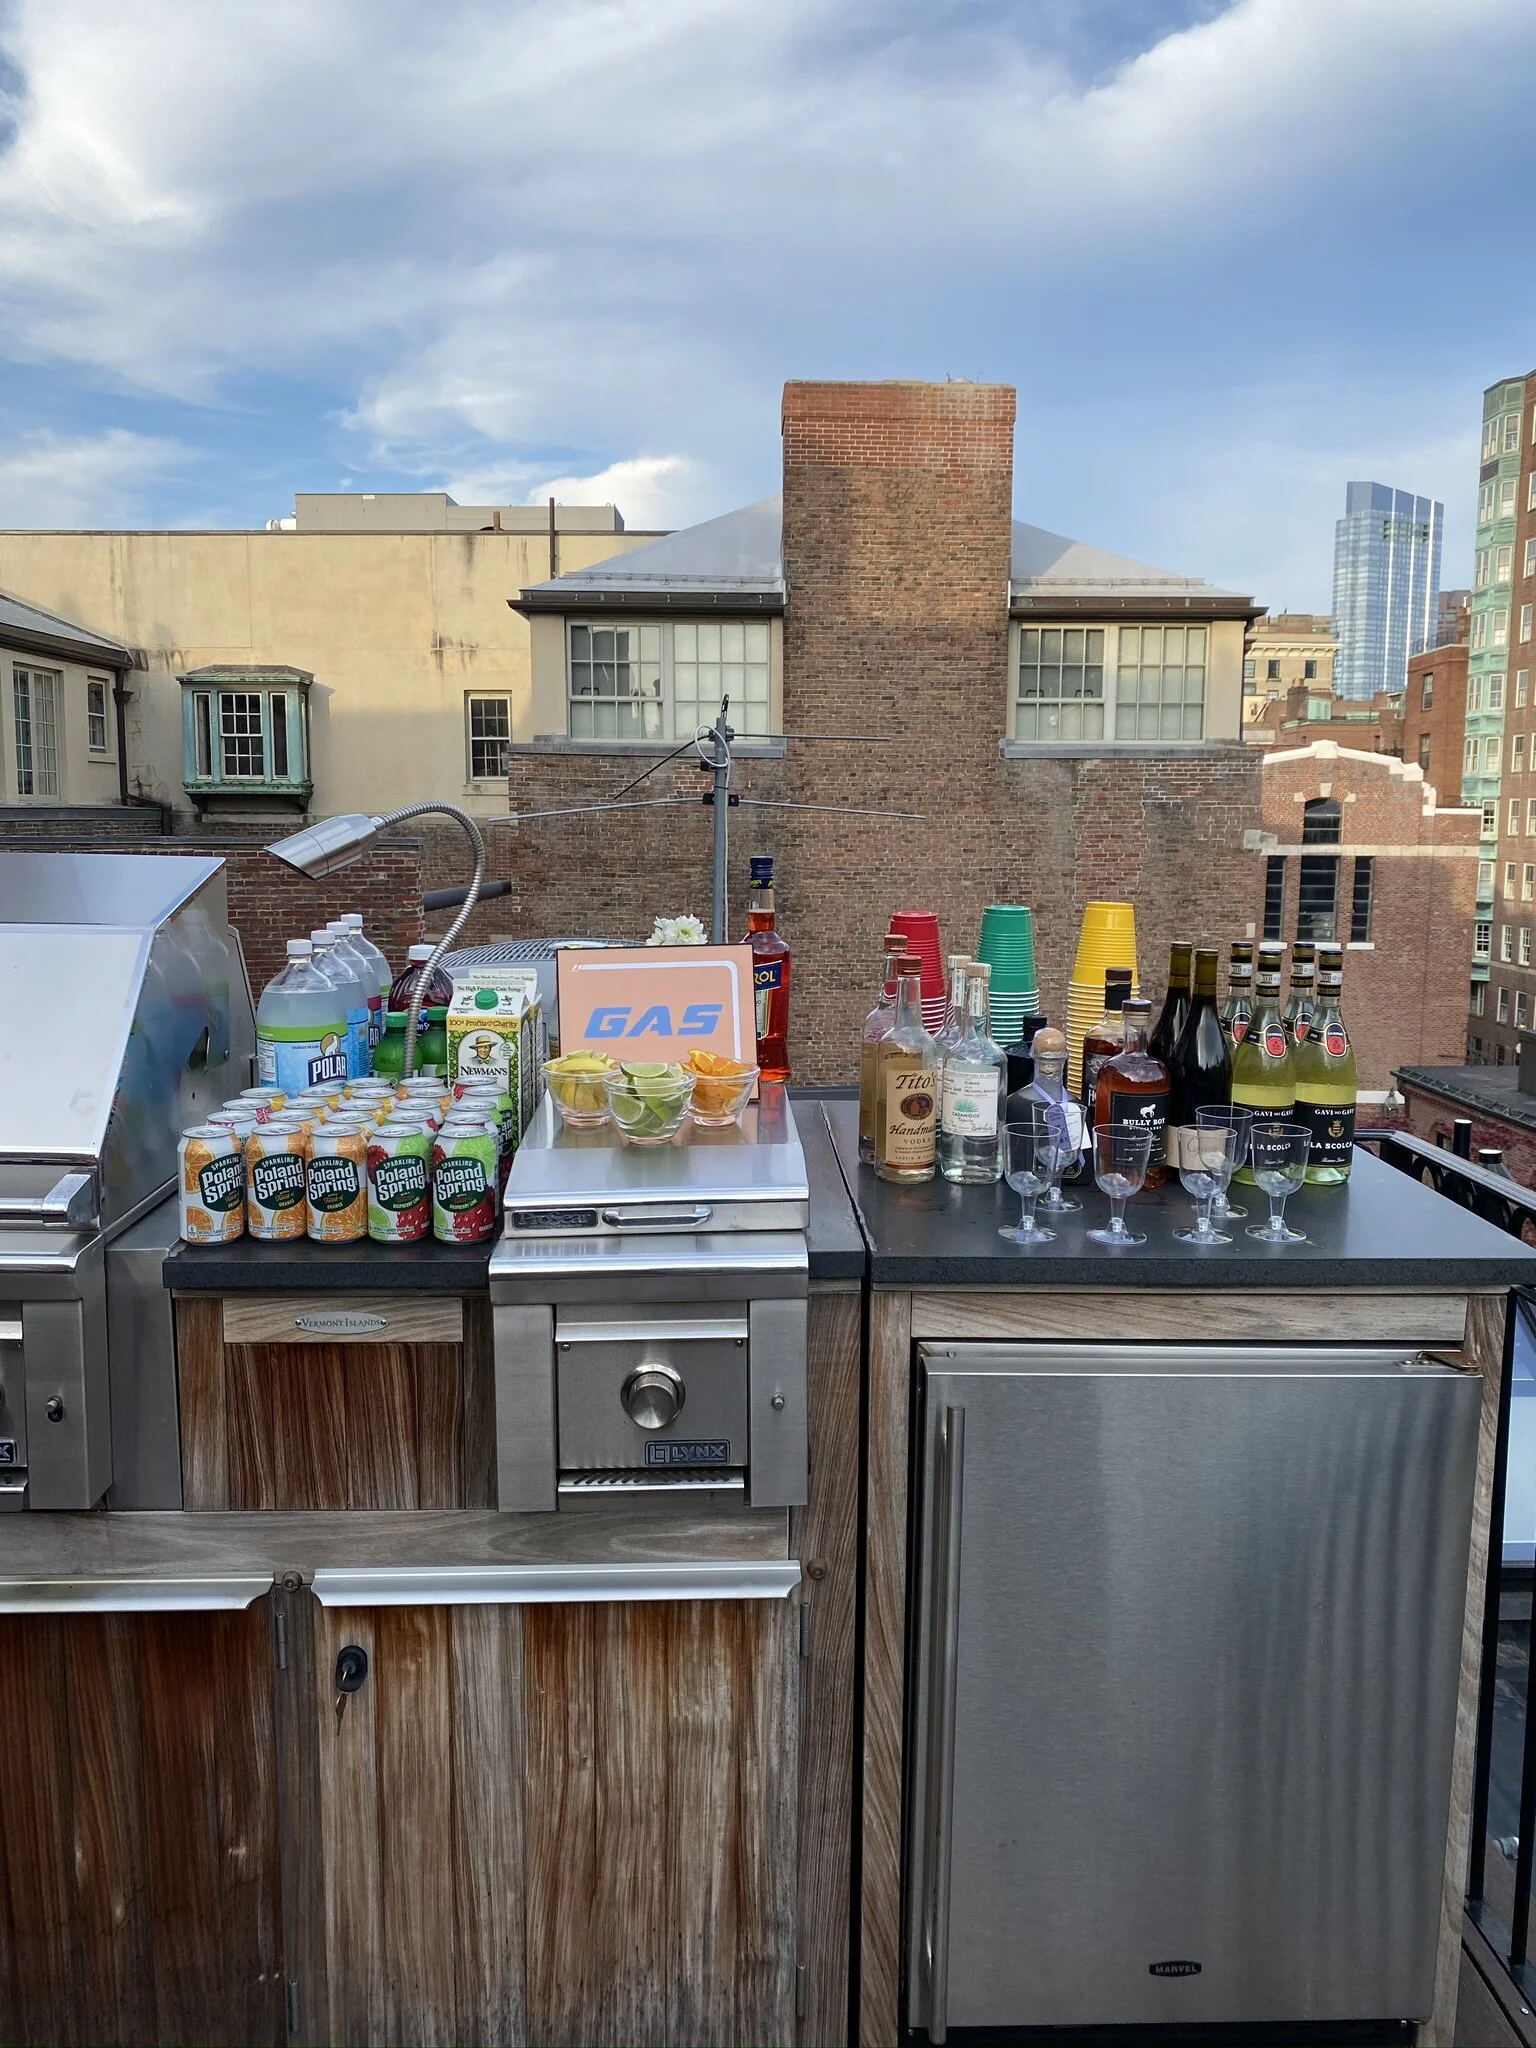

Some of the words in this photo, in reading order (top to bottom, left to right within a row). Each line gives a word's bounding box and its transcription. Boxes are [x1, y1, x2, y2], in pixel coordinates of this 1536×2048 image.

[493, 1020, 518, 1028] Charity
[583, 1003, 723, 1039] GAS
[312, 1055, 347, 1083] POLAR
[460, 1066, 508, 1076] NEWMAN'S
[1314, 1108, 1333, 1116] GAVI
[1122, 1118, 1151, 1126] BULLY
[1153, 1117, 1166, 1125] BOY
[1310, 1141, 1322, 1149] LA
[261, 1156, 294, 1168] SPARKLING
[312, 1160, 344, 1169] SPARKLING
[383, 1158, 416, 1169] SPARKLING
[441, 1160, 473, 1169] SPARKLING
[254, 1157, 304, 1185] Poland
[308, 1162, 355, 1185] Poland
[376, 1160, 424, 1186] Poland
[436, 1162, 483, 1185] Poland
[256, 1173, 305, 1200] Spring
[309, 1177, 357, 1201] Spring
[377, 1175, 425, 1201] Spring
[436, 1177, 485, 1201] Spring
[301, 1318, 343, 1328] VERMONT
[345, 1317, 380, 1328] ISLANDS
[672, 1445, 725, 1460] LYNX
[1155, 1965, 1198, 1973] MARVEL
